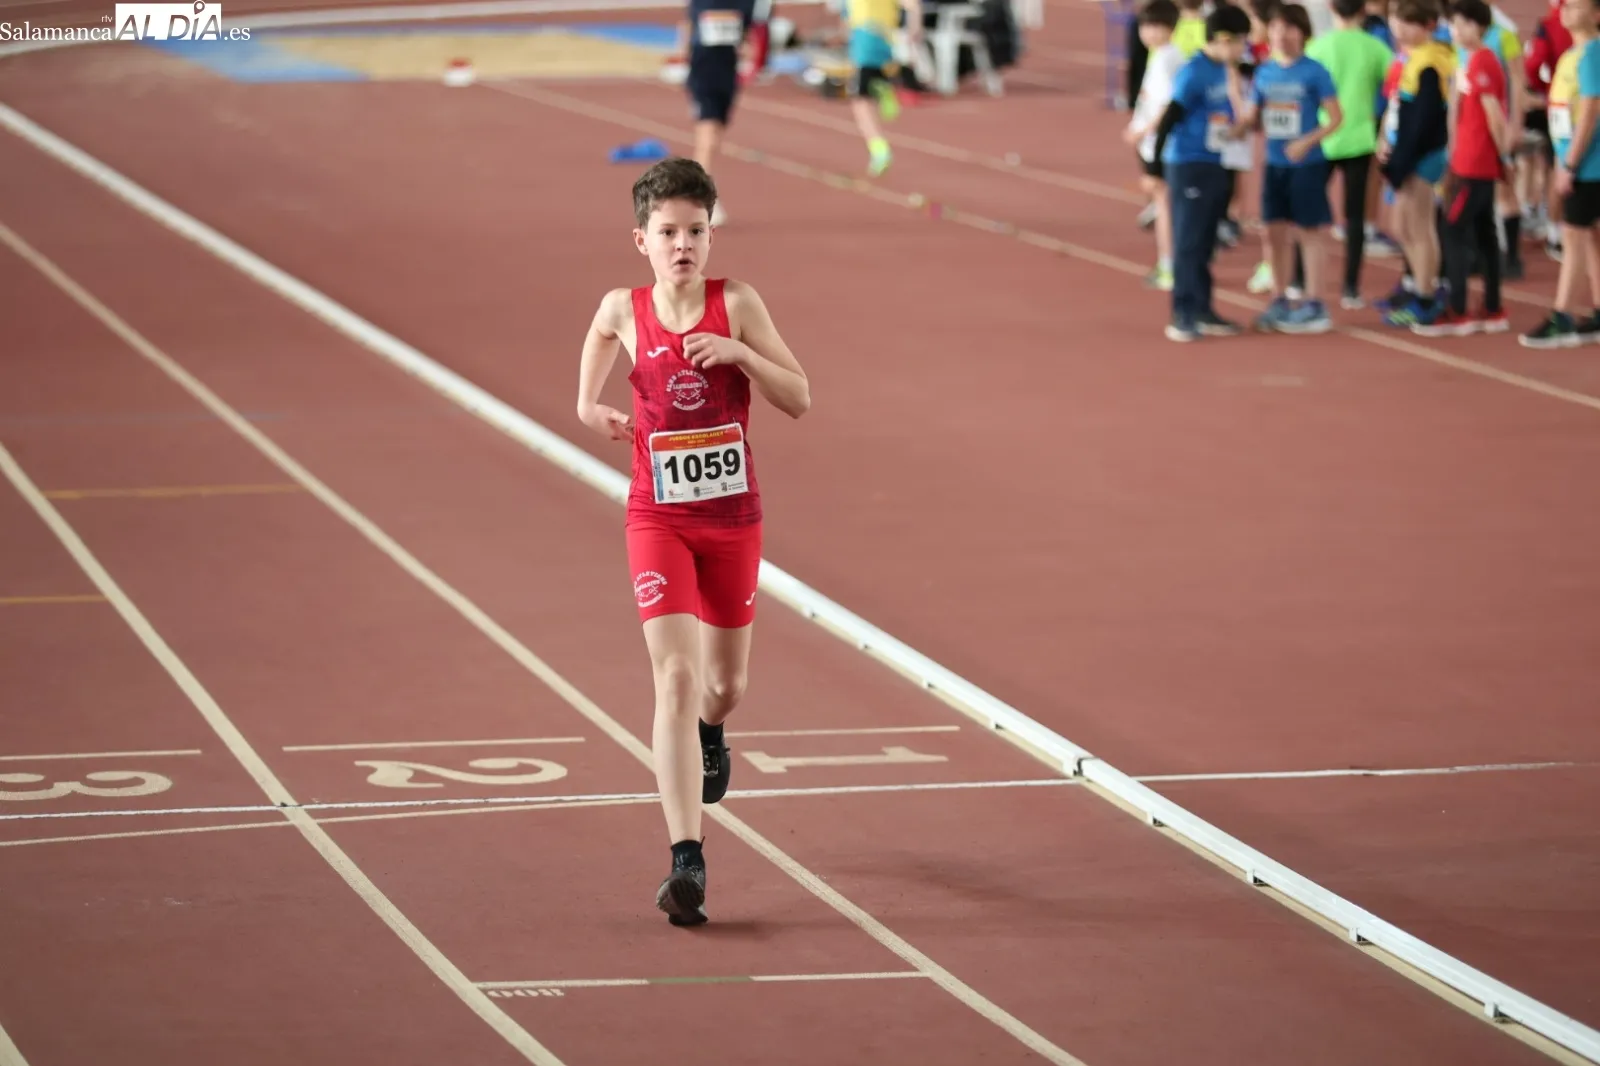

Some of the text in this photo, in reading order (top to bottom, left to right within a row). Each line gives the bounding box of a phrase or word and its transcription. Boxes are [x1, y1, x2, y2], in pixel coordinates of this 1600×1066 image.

[664, 448, 741, 484] 1059
[354, 757, 568, 788] 2
[740, 746, 949, 773] 1
[0, 770, 173, 800] 3
